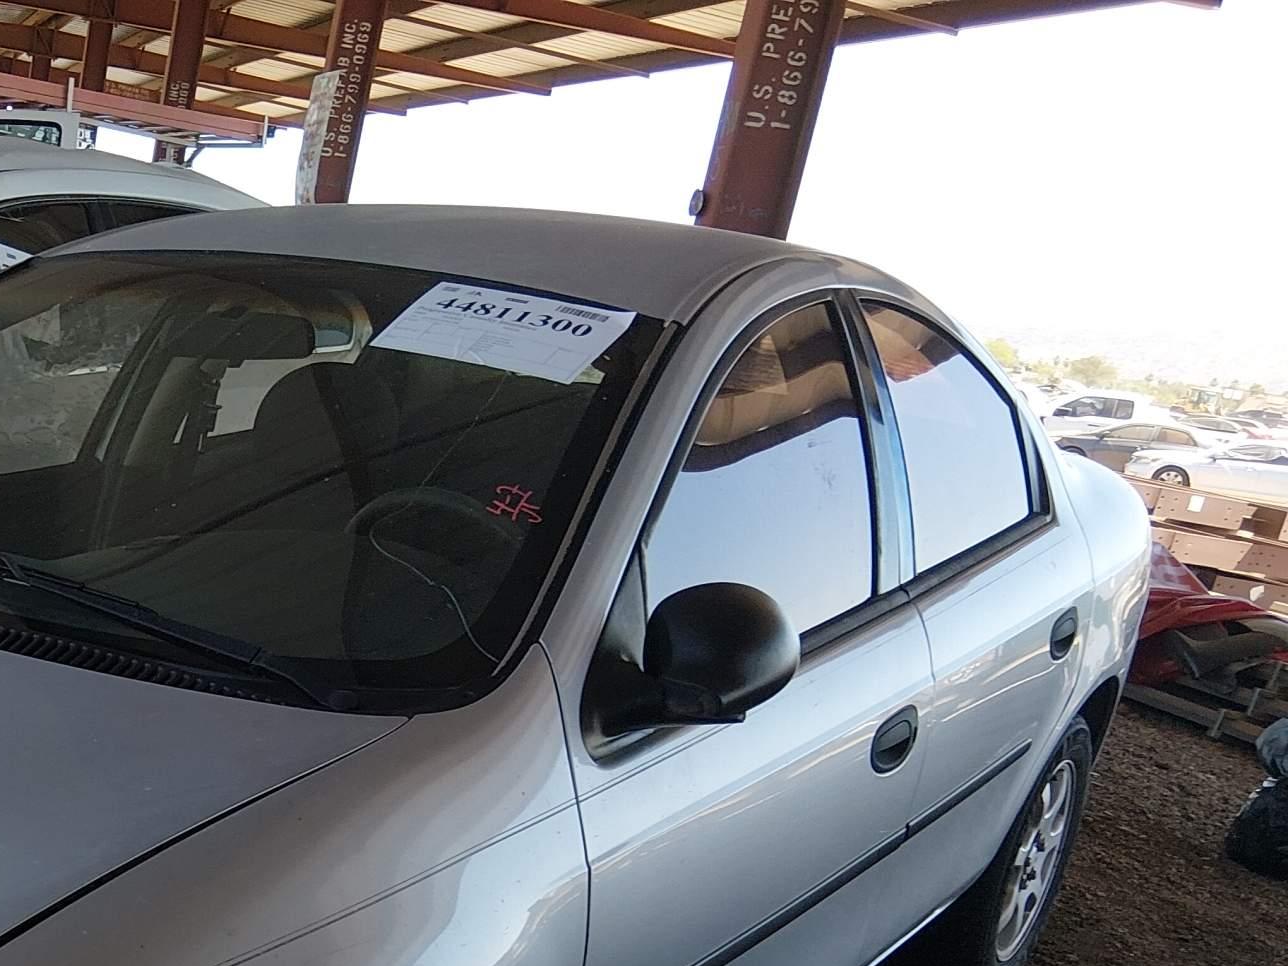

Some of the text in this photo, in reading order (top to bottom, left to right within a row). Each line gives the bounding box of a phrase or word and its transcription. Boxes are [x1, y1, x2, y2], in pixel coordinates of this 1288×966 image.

[340, 19, 358, 49] INC.
[761, 0, 796, 59] PRE
[333, 21, 372, 158] 1-866-799-0969
[436, 297, 593, 337] 44811300
